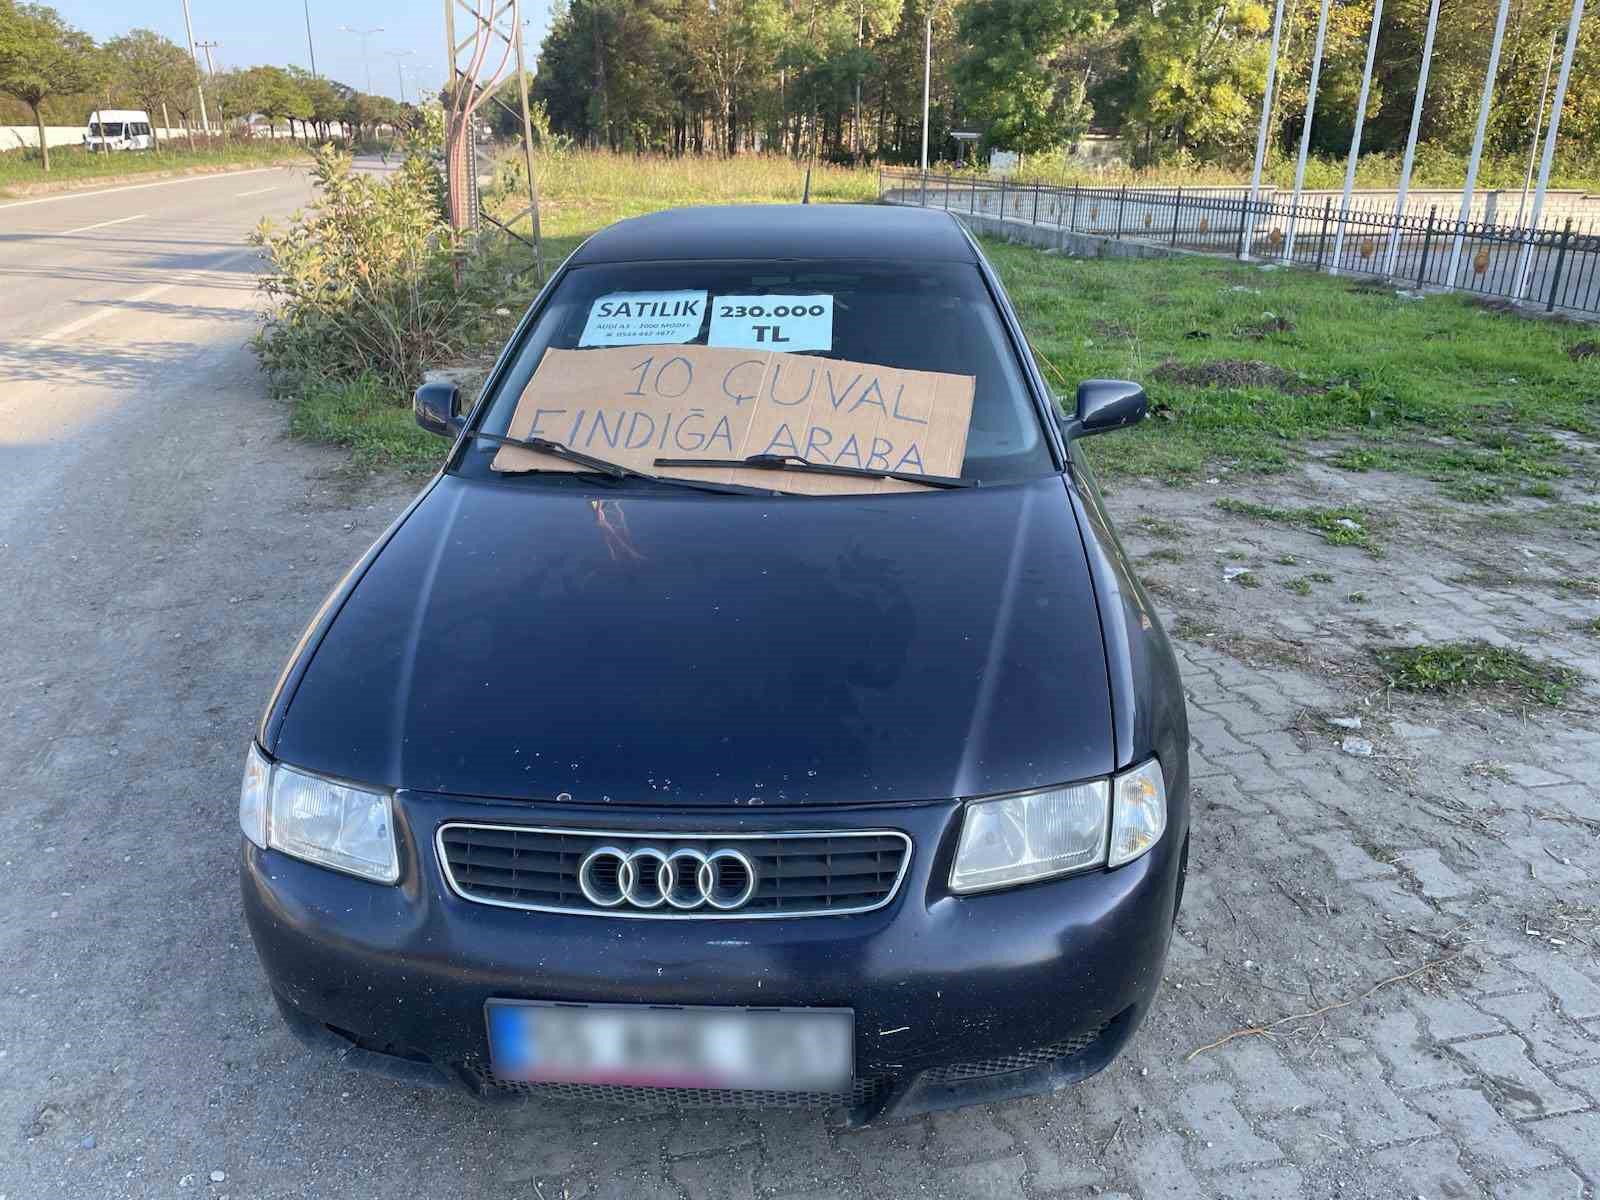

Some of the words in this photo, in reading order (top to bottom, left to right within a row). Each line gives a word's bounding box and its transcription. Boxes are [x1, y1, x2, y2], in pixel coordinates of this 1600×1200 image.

[596, 300, 700, 318] SATILIK
[720, 304, 825, 318] 230.000
[751, 325, 790, 343] TL
[624, 355, 693, 398] 10
[722, 360, 928, 425] ÇUVAL
[763, 423, 925, 475] ARABA
